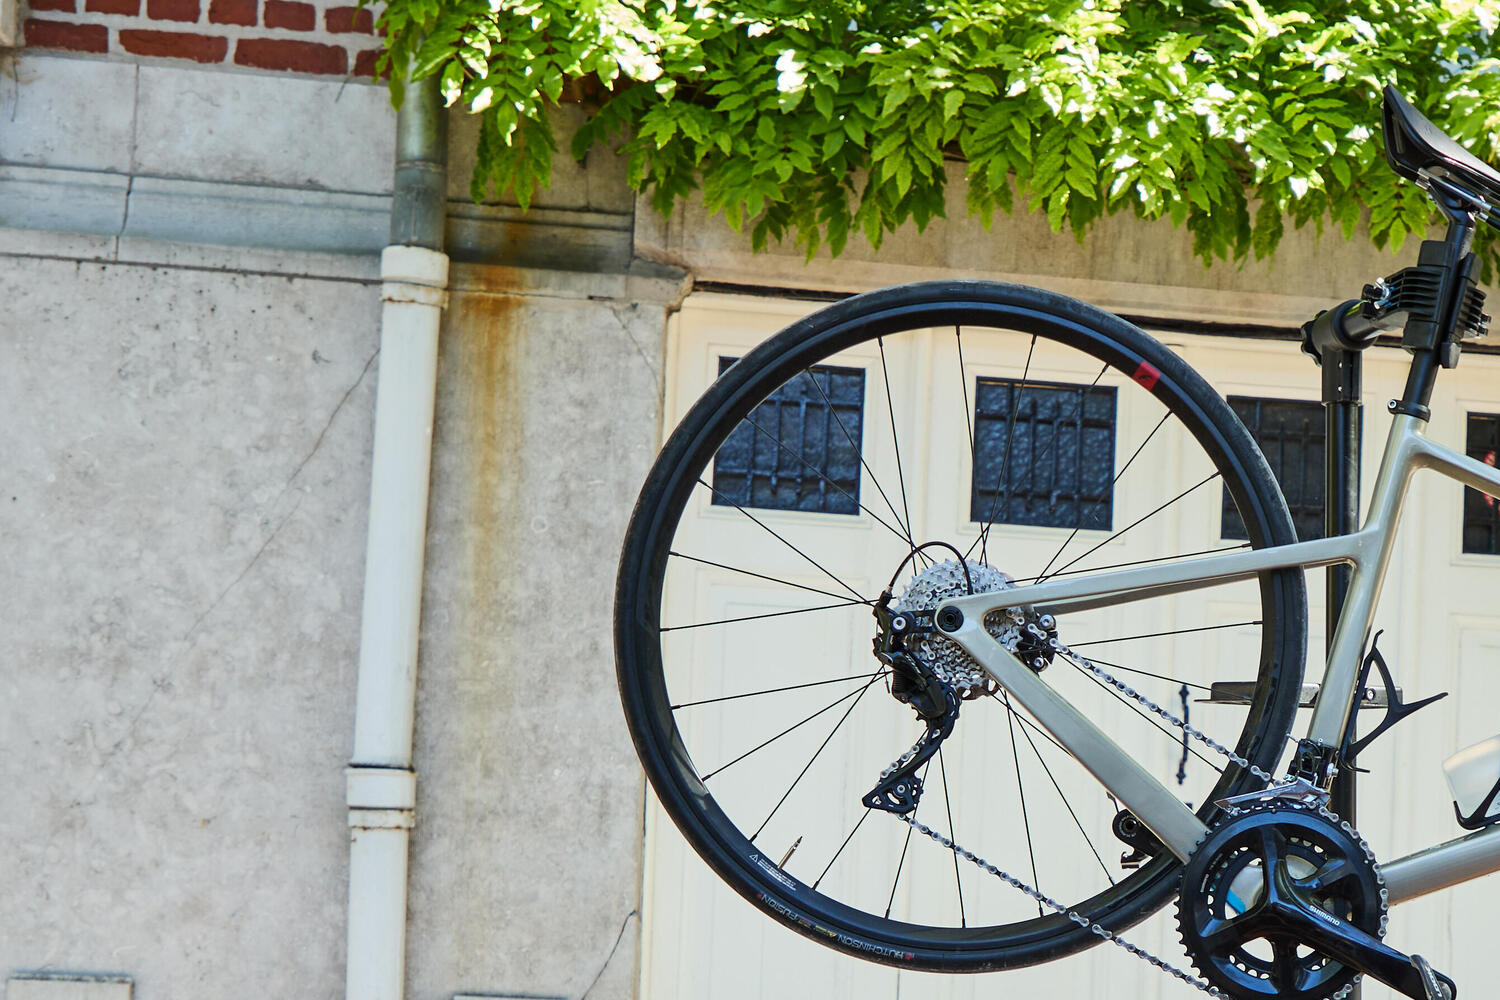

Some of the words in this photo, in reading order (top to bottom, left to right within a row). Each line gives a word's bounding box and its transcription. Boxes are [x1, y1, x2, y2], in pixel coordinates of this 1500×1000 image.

[761, 894, 800, 922] FUSION
[1309, 904, 1341, 926] SHIMANO
[837, 933, 904, 961] HUTCHINSON
